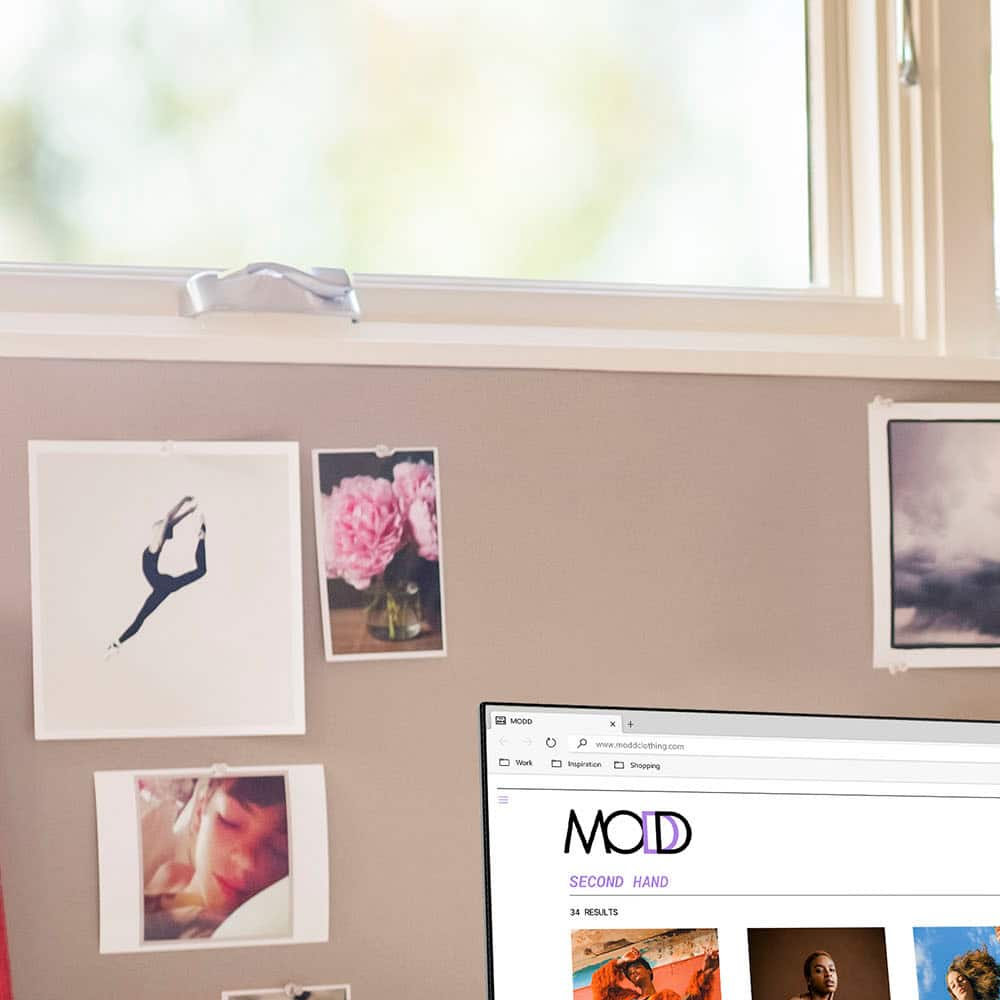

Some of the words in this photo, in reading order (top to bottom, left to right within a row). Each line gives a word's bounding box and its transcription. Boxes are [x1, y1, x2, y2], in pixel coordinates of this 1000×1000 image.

[596, 742, 684, 751] www.moddclothing.com
[630, 762, 660, 770] Shopping
[564, 809, 692, 854] MODD
[570, 875, 624, 888] SECOND
[633, 876, 668, 888] HAND
[585, 908, 618, 916] RESULTS
